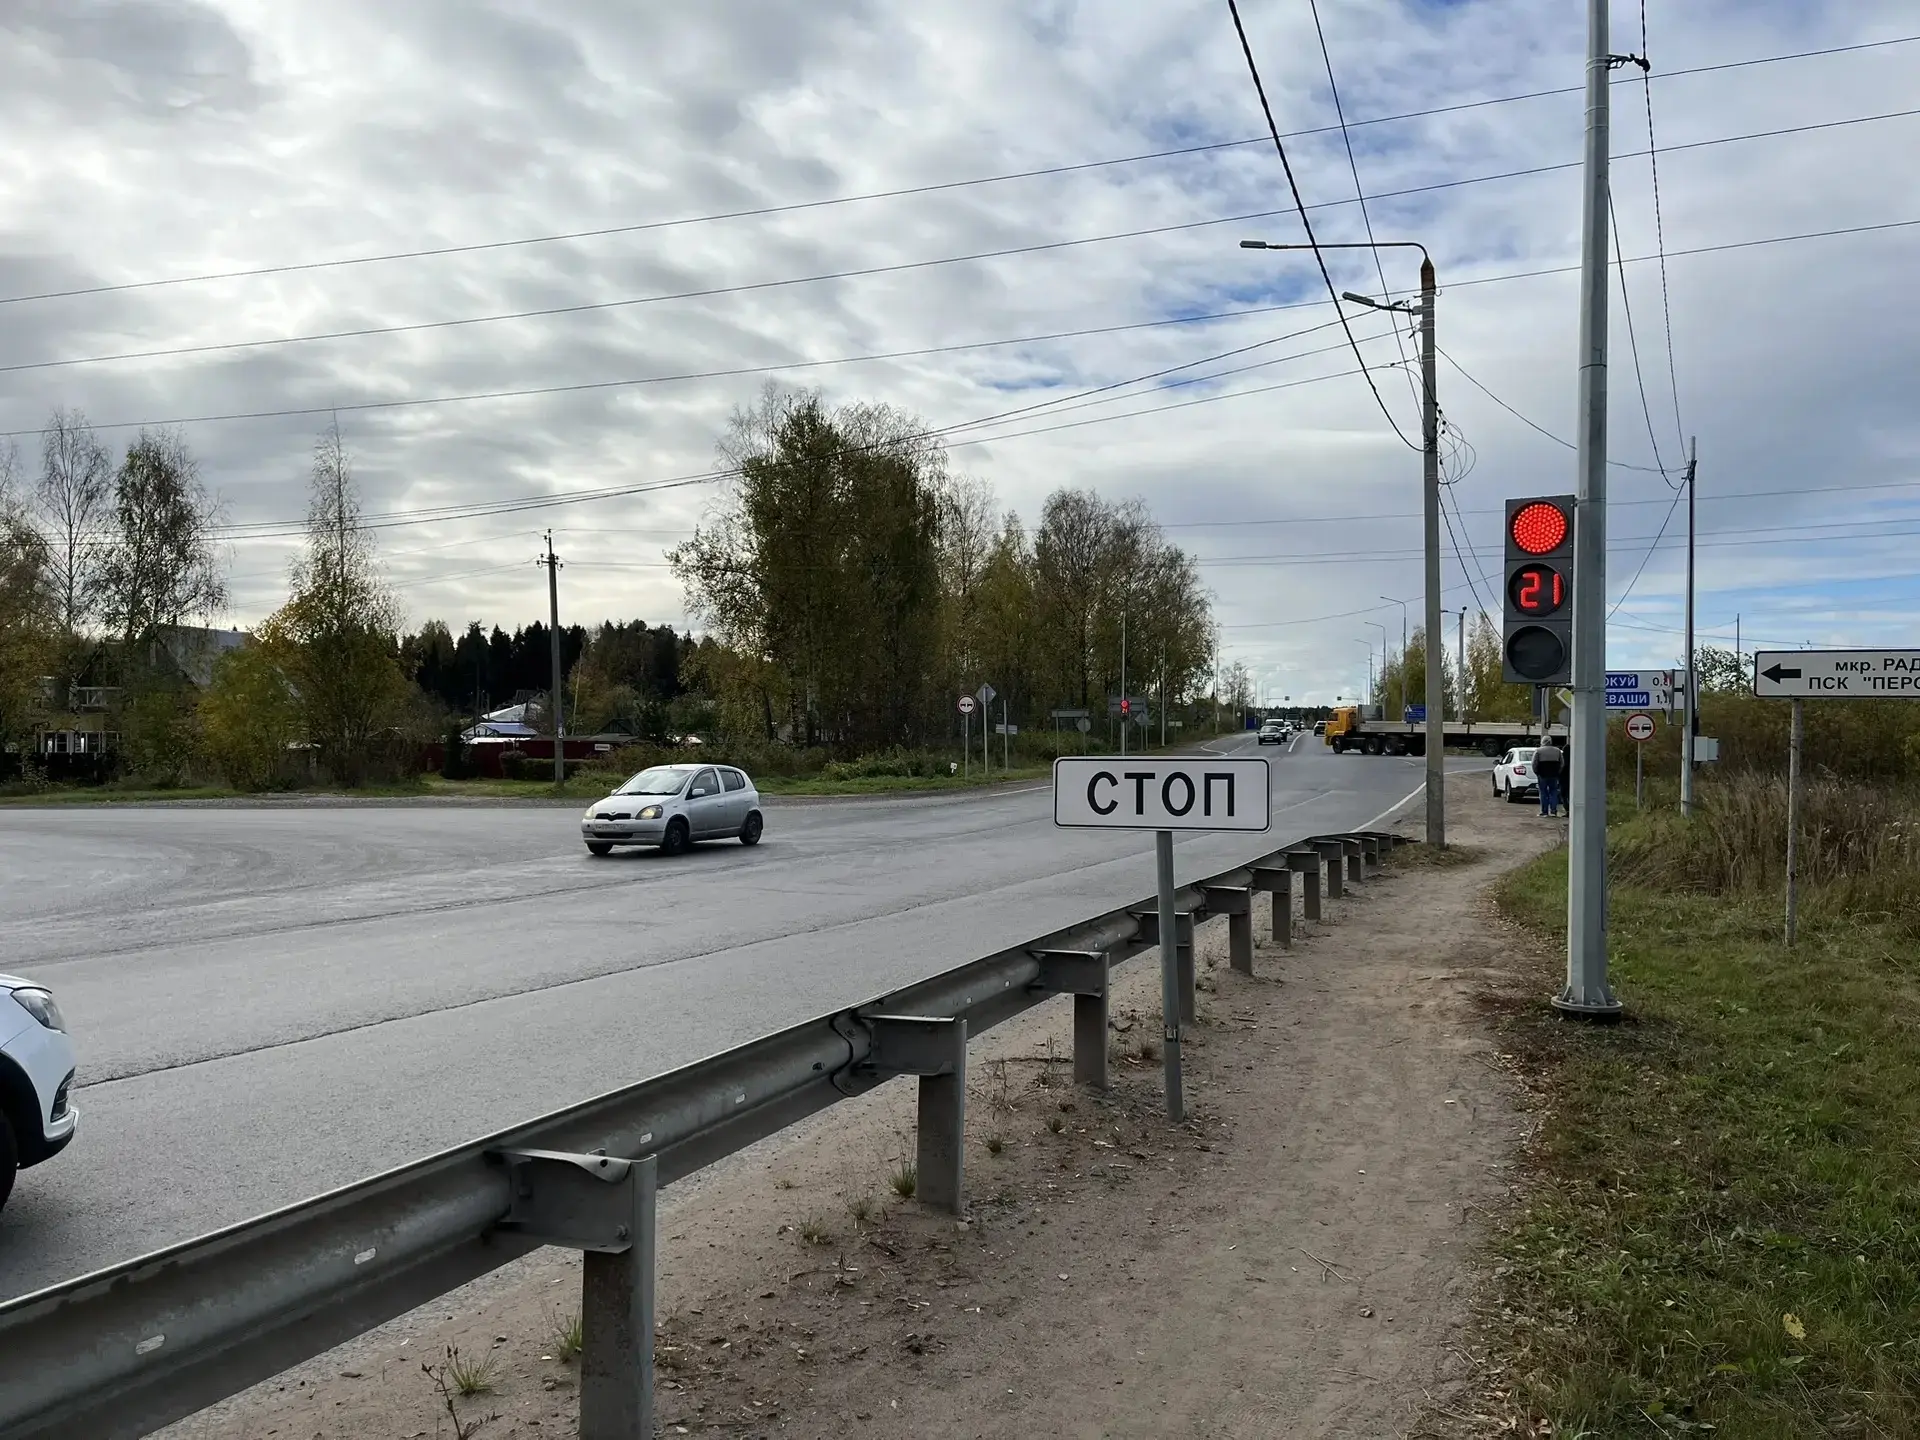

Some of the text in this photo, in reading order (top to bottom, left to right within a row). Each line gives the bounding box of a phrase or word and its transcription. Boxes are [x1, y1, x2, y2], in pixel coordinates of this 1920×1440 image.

[1520, 572, 1561, 608] 21
[1835, 661, 1876, 674] мкр.
[1808, 677, 1849, 690] ПСК
[1605, 694, 1648, 704] ВАШИ
[1087, 771, 1235, 817] СТОП
